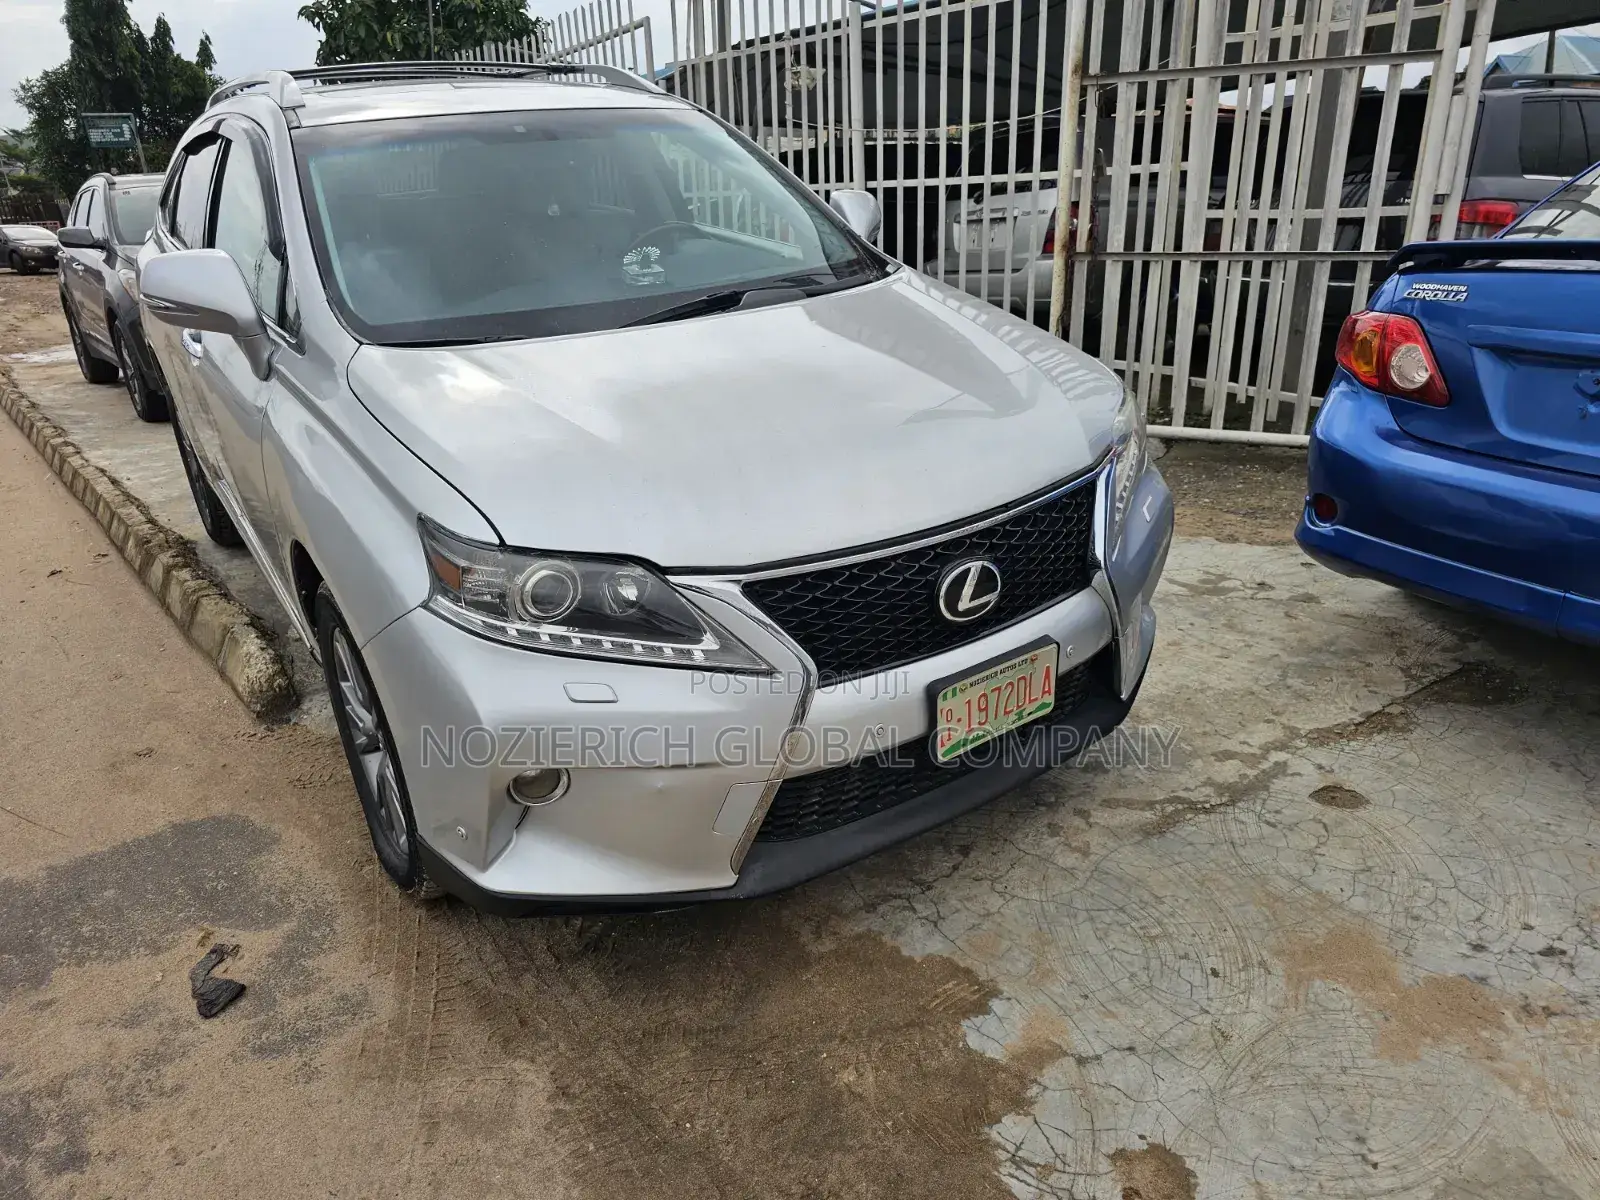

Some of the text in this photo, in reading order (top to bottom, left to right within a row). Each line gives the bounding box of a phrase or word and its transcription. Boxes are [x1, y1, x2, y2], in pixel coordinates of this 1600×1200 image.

[1412, 283, 1468, 292] WOODHAVEN
[1403, 289, 1468, 301] COROLLA
[1000, 663, 1017, 675] AUTOS
